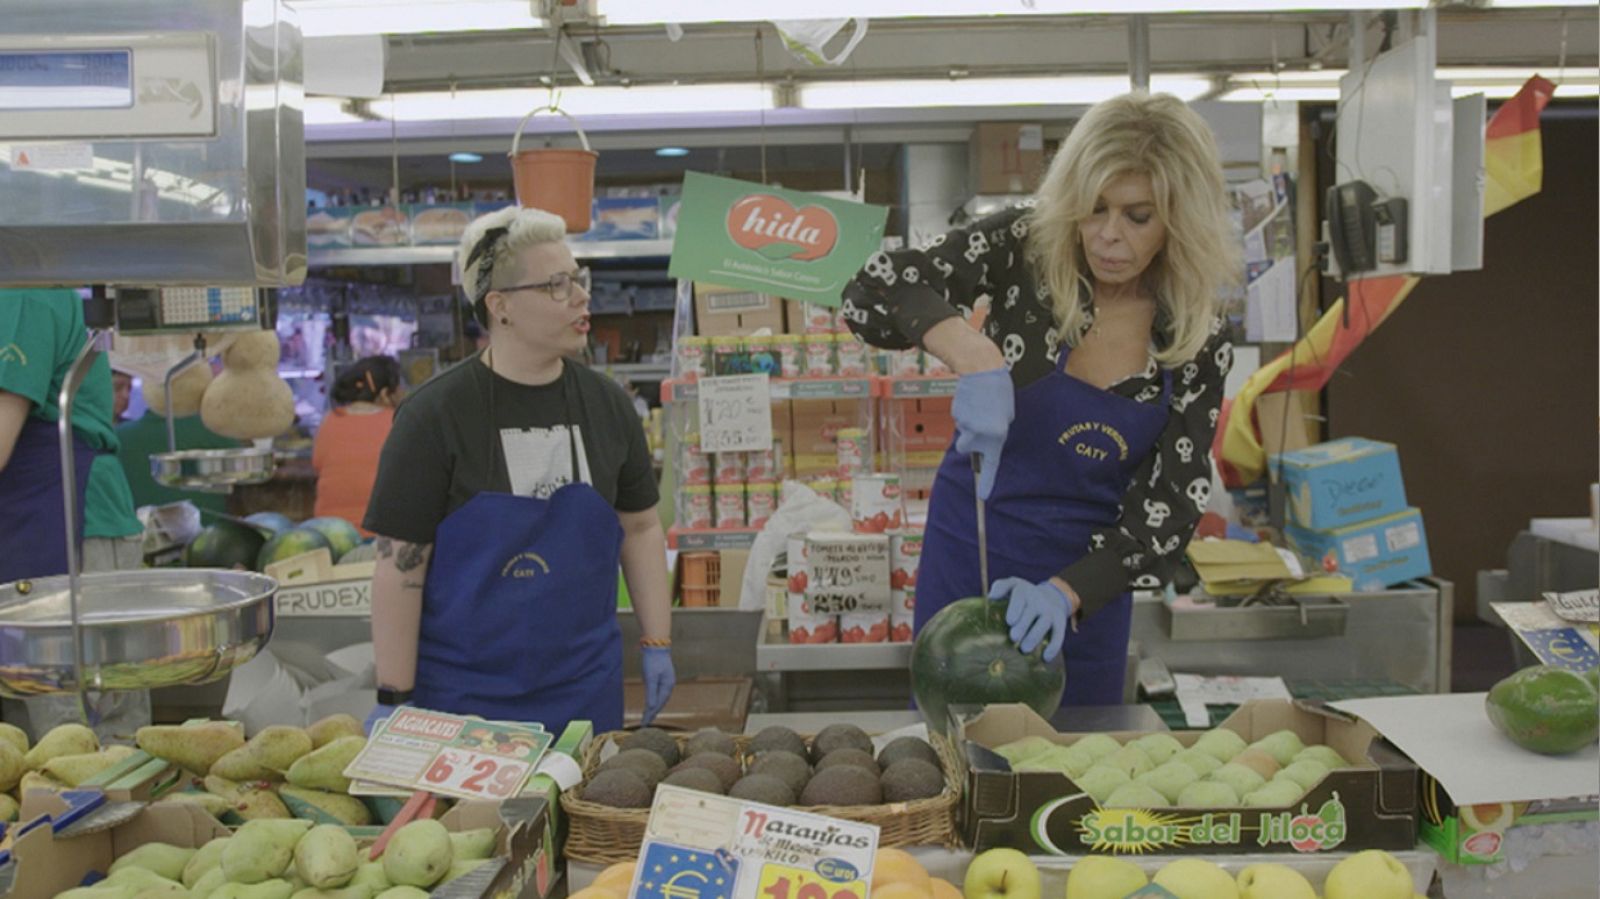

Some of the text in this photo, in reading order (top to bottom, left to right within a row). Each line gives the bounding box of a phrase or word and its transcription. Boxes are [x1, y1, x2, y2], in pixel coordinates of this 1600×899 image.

[742, 206, 822, 246] hida
[1075, 442, 1109, 462] CATY
[276, 585, 369, 613] FRUDEX
[425, 753, 523, 798] 6'29
[743, 808, 870, 849] Naranjas
[1080, 812, 1345, 847] Sabor del Jiloca
